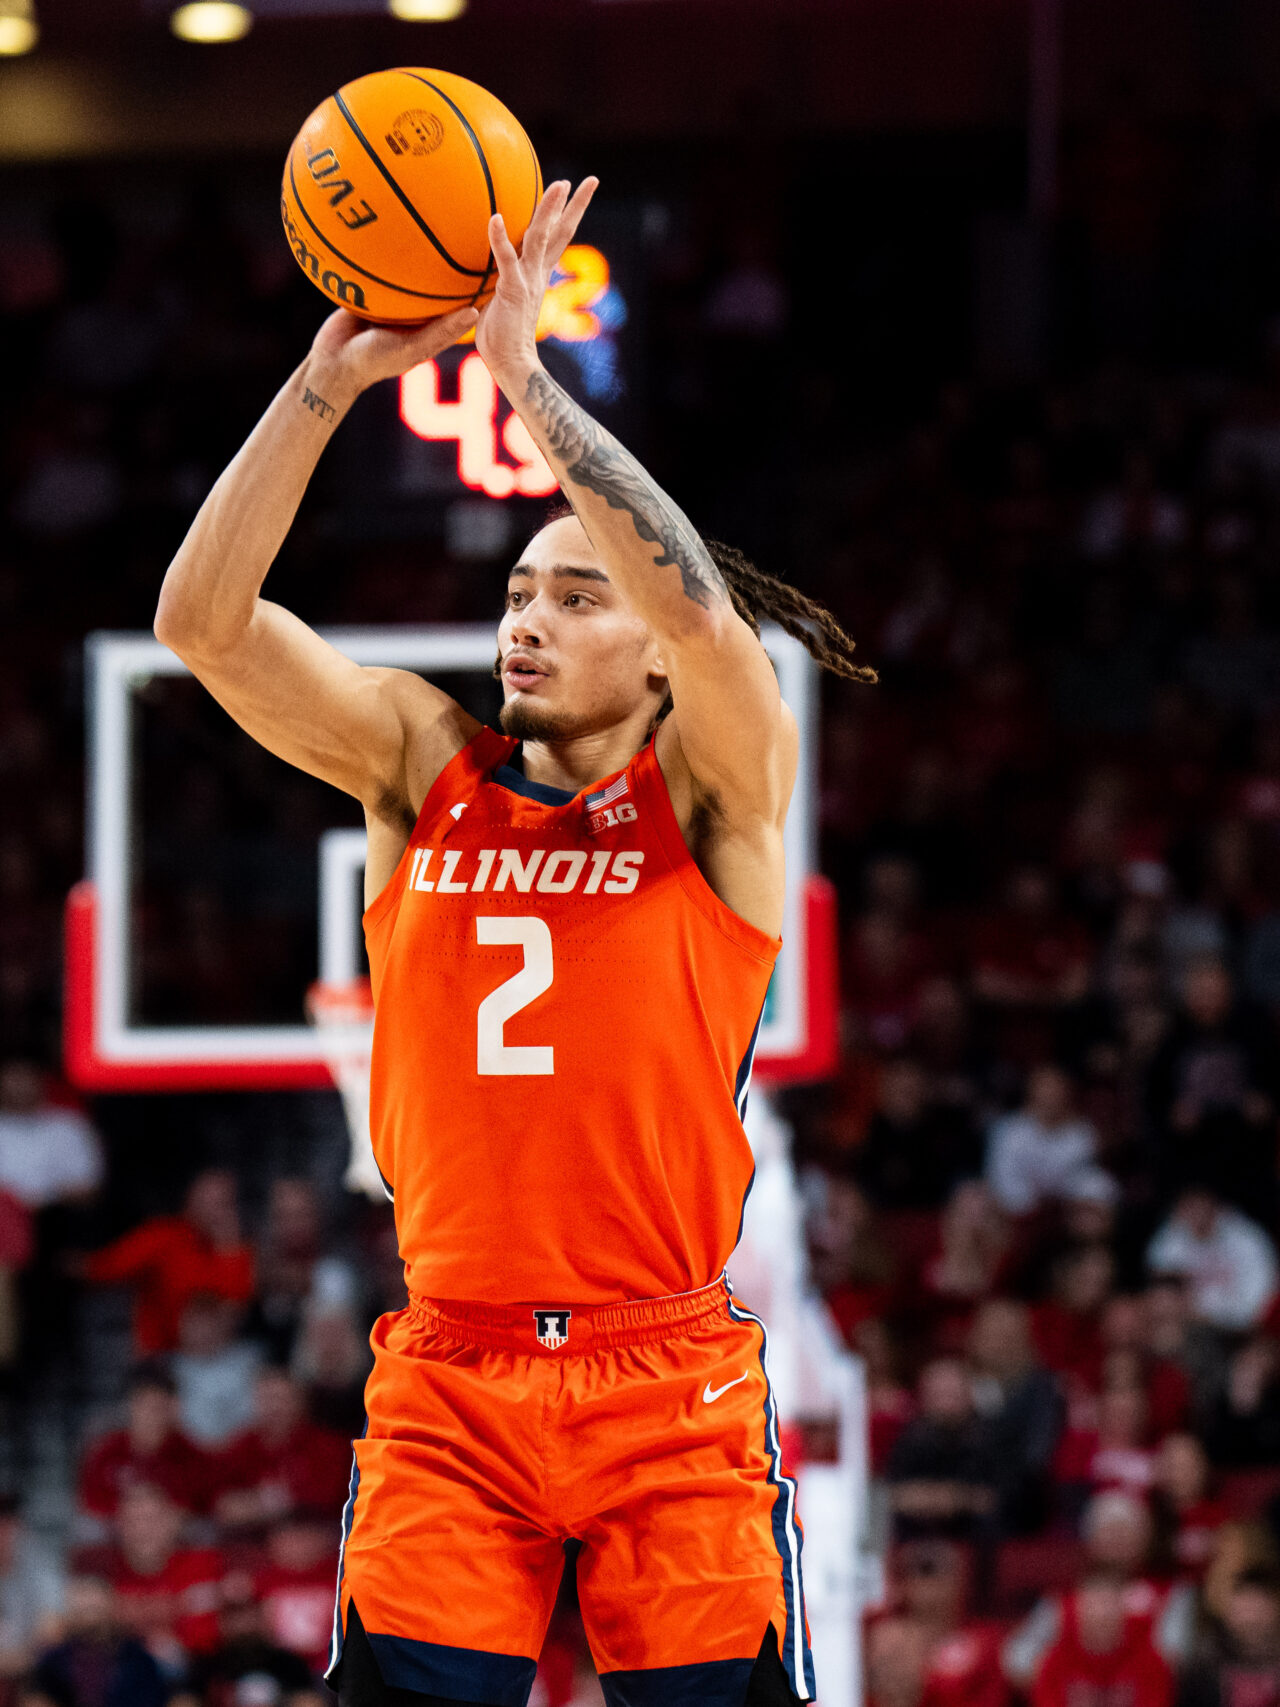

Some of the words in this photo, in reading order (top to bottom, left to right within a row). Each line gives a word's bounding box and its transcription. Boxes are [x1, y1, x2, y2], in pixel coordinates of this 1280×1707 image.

[306, 145, 378, 230] EVO
[408, 847, 645, 894] ILLINOIS
[476, 916, 555, 1075] 2
